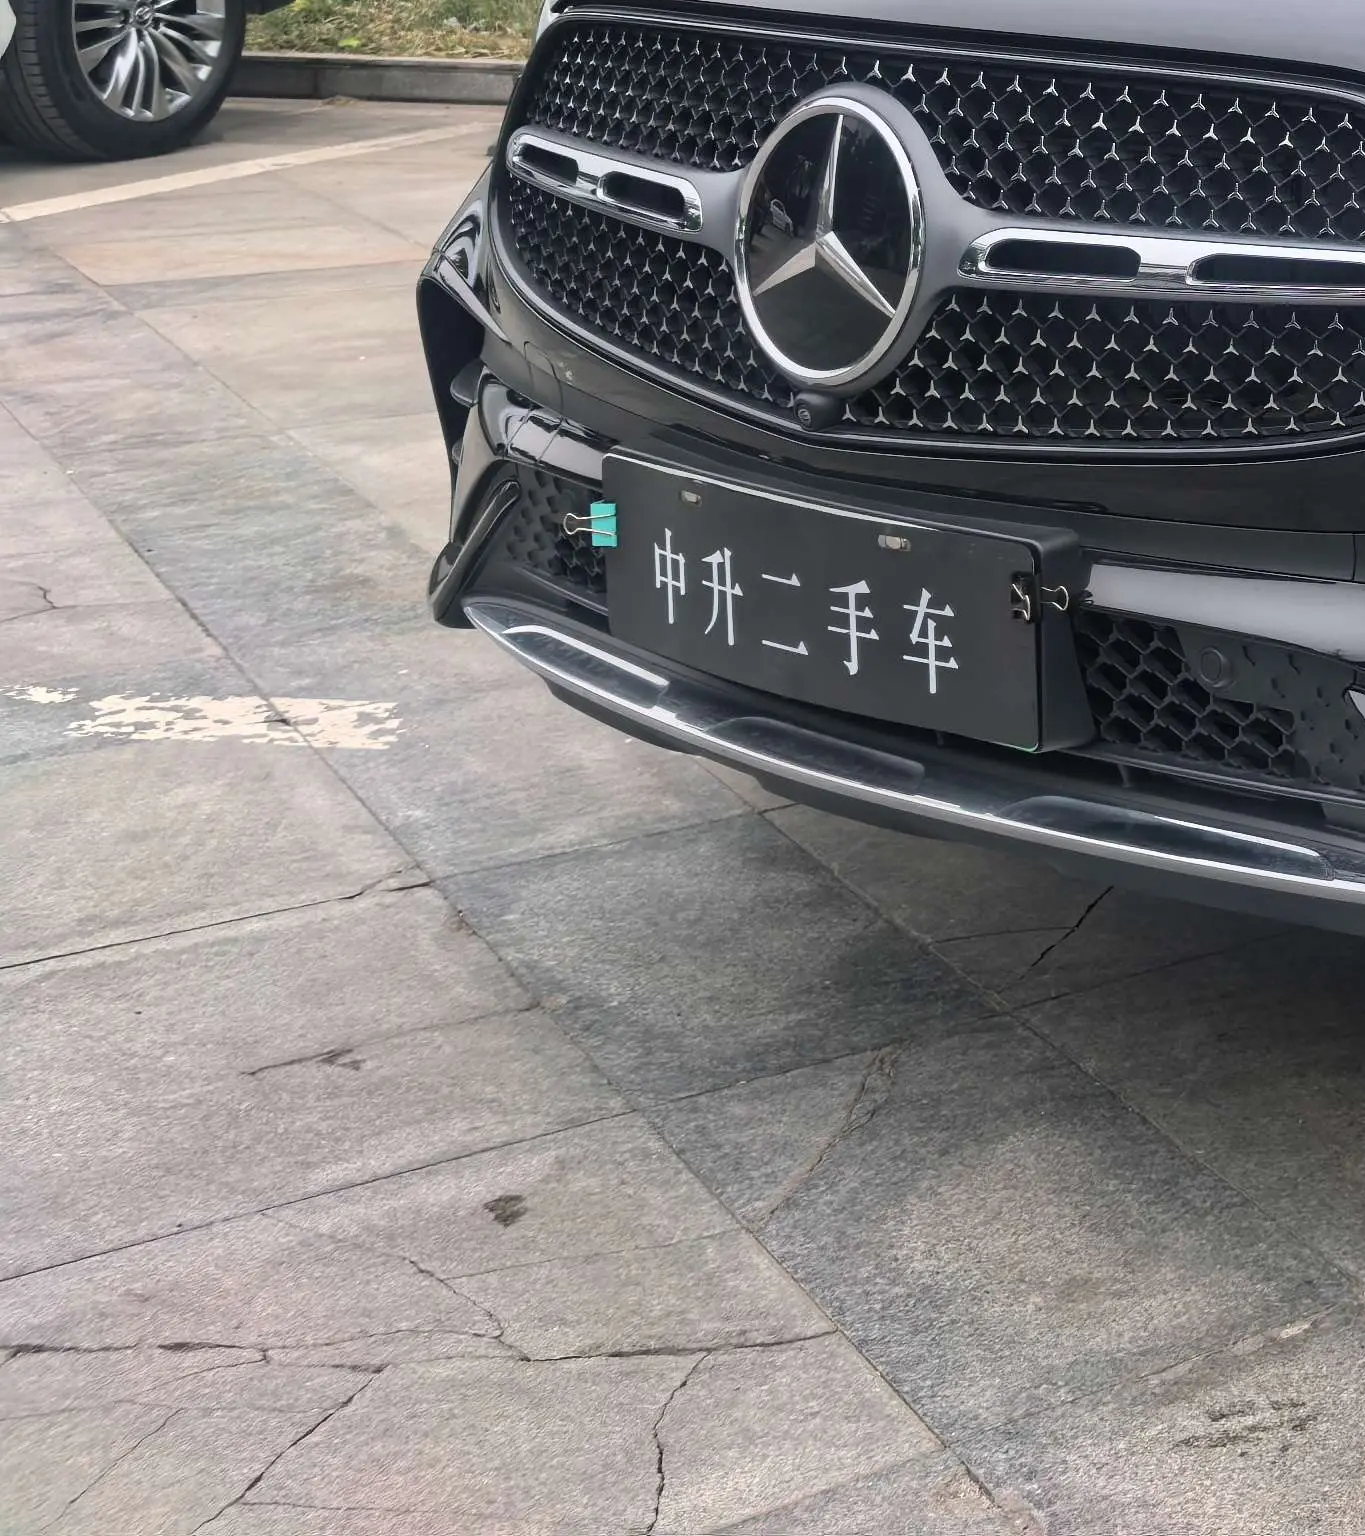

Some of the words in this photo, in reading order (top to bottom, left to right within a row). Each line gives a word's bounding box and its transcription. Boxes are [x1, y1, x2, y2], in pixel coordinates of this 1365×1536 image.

[652, 527, 959, 695] 中升二手车
